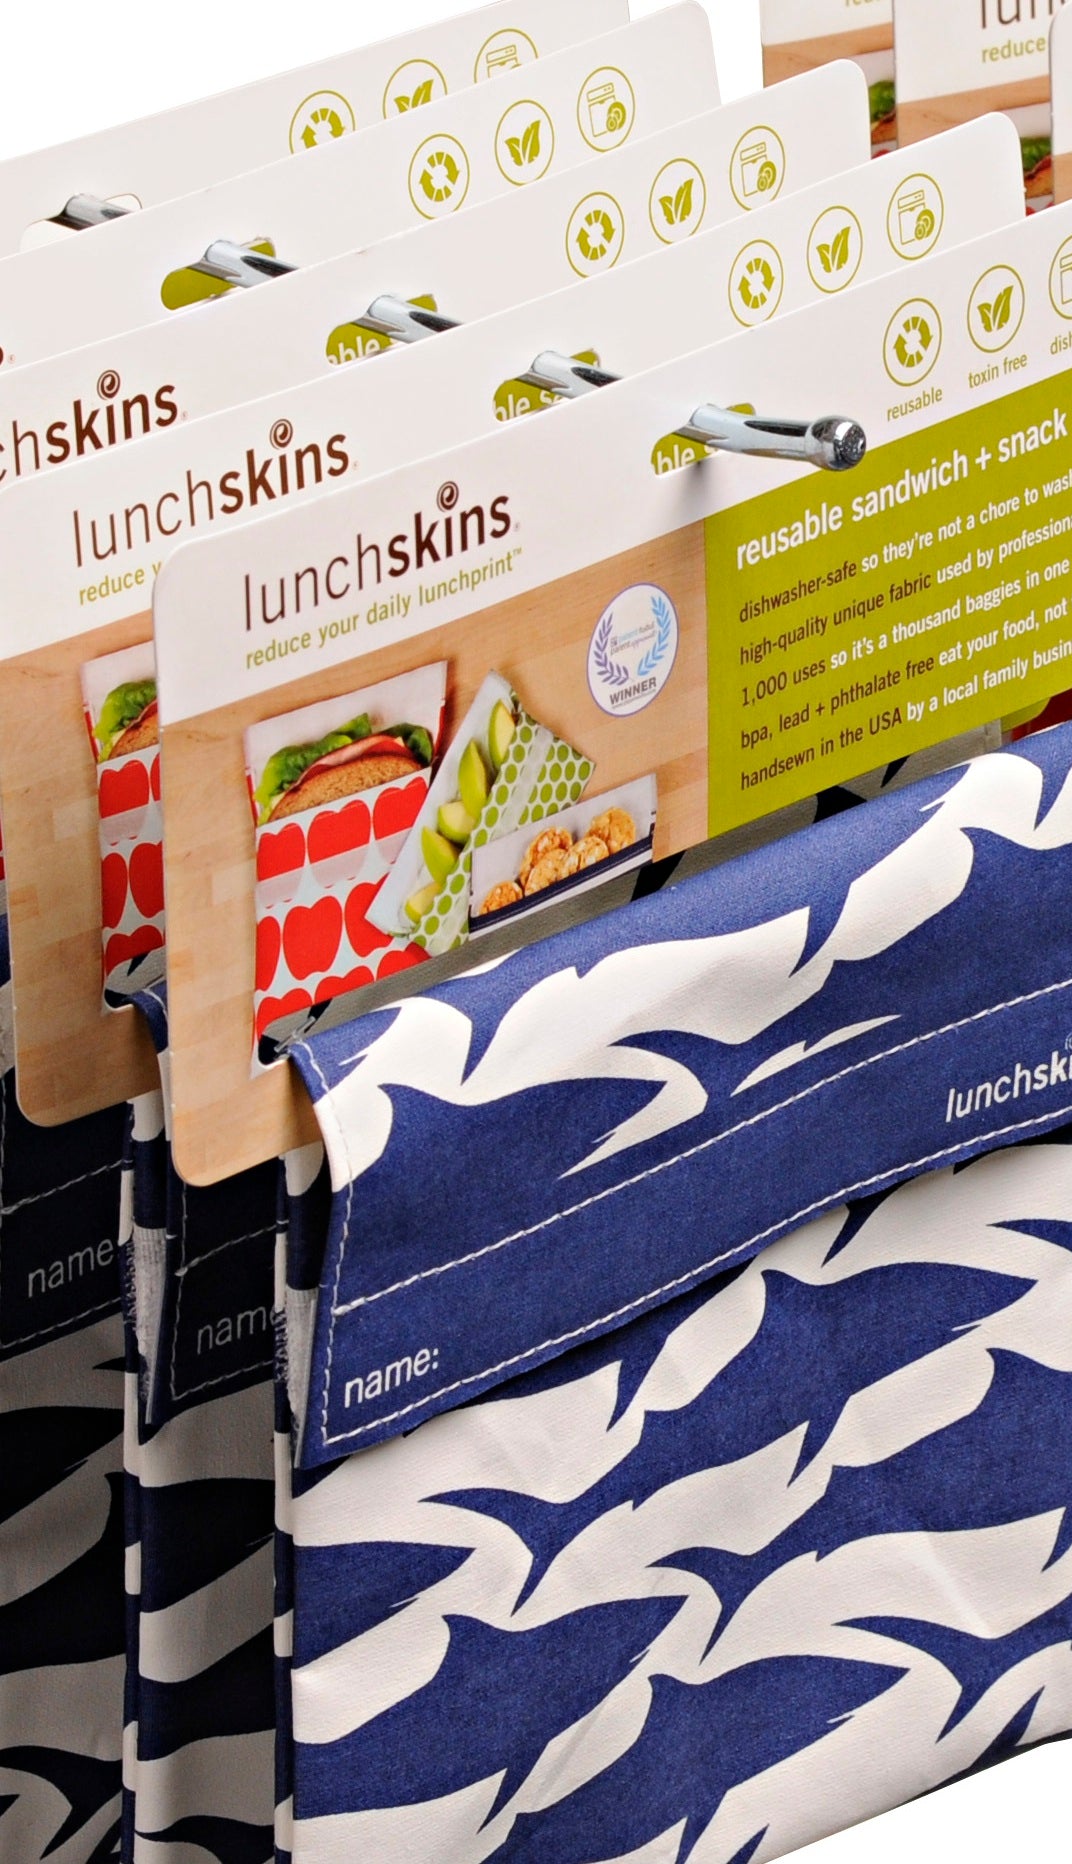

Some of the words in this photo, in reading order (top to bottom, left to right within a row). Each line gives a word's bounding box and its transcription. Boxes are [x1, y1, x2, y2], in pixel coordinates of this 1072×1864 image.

[981, 37, 1046, 63] reduce
[886, 387, 944, 423] reusable
[967, 363, 999, 390] toxin
[1002, 351, 1028, 379] free
[73, 418, 349, 568] lunchskins
[736, 504, 843, 571] reusable
[852, 449, 968, 524] sandwich
[975, 446, 992, 472] +
[998, 408, 1068, 464] snack
[79, 567, 146, 606] reduce
[244, 480, 513, 632] lunchskins
[739, 561, 858, 624] dishwasher-safe
[861, 553, 879, 574] so
[883, 528, 934, 565] they're
[938, 516, 963, 543] not
[966, 512, 976, 531] a
[980, 495, 1020, 526] chore
[1025, 484, 1040, 505] to
[245, 631, 312, 670] reduce
[318, 614, 360, 646] your
[366, 593, 412, 625] daily
[739, 617, 829, 667] high-quality
[833, 592, 885, 628] unique
[889, 572, 932, 605] fabric
[936, 558, 973, 585] used
[976, 546, 994, 568] by
[741, 673, 788, 708] 1,000
[792, 660, 826, 685] uses
[830, 650, 848, 670] so
[851, 636, 875, 662] it's
[878, 632, 888, 649] a
[892, 606, 961, 645] thousand
[965, 577, 1022, 615] baggies
[1026, 571, 1041, 591] in
[1044, 557, 1071, 582] one
[609, 677, 657, 705] WINNER
[740, 745, 816, 790] handsewn
[820, 737, 834, 758] in
[839, 726, 864, 750] the
[869, 707, 903, 737] USA
[907, 701, 925, 723] by
[929, 694, 939, 711] a
[943, 674, 979, 706] local
[983, 656, 1028, 691] family
[741, 724, 774, 750] bpa,
[778, 701, 811, 732] lead
[814, 702, 826, 719] +
[830, 666, 901, 721] phthalate
[905, 655, 935, 682] free
[939, 645, 963, 667] eat
[966, 631, 998, 662] your
[1003, 612, 1040, 647] food,
[1044, 601, 1068, 623] not
[28, 1238, 114, 1299] name
[343, 1346, 440, 1409] name:
